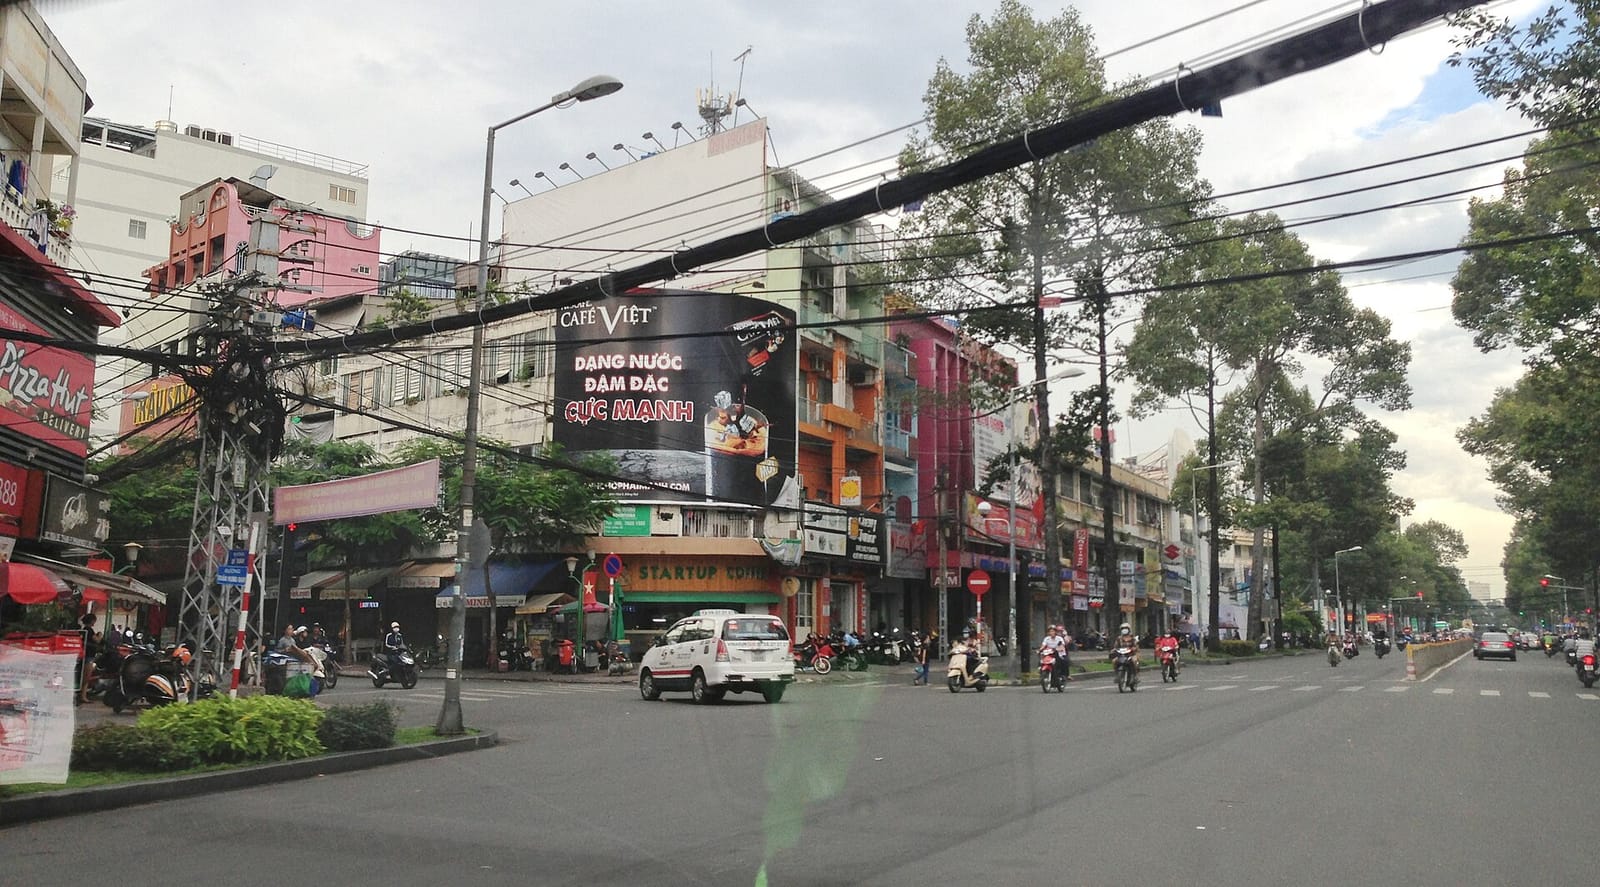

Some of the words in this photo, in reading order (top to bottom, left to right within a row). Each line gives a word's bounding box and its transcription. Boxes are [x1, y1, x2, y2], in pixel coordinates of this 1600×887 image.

[560, 307, 596, 328] CAFÉ
[597, 304, 652, 335] VIỆT
[575, 354, 625, 372] DẠNG
[629, 352, 682, 370] NƯỚC
[0, 341, 49, 402] Pizza
[50, 367, 89, 418] Hut
[584, 374, 626, 393] ĐẬM
[630, 374, 669, 393] ĐẶC
[42, 410, 86, 439] DELIVERY
[564, 396, 607, 427] CỰC
[611, 399, 694, 423] MẠNH
[639, 566, 717, 580] STARTUP
